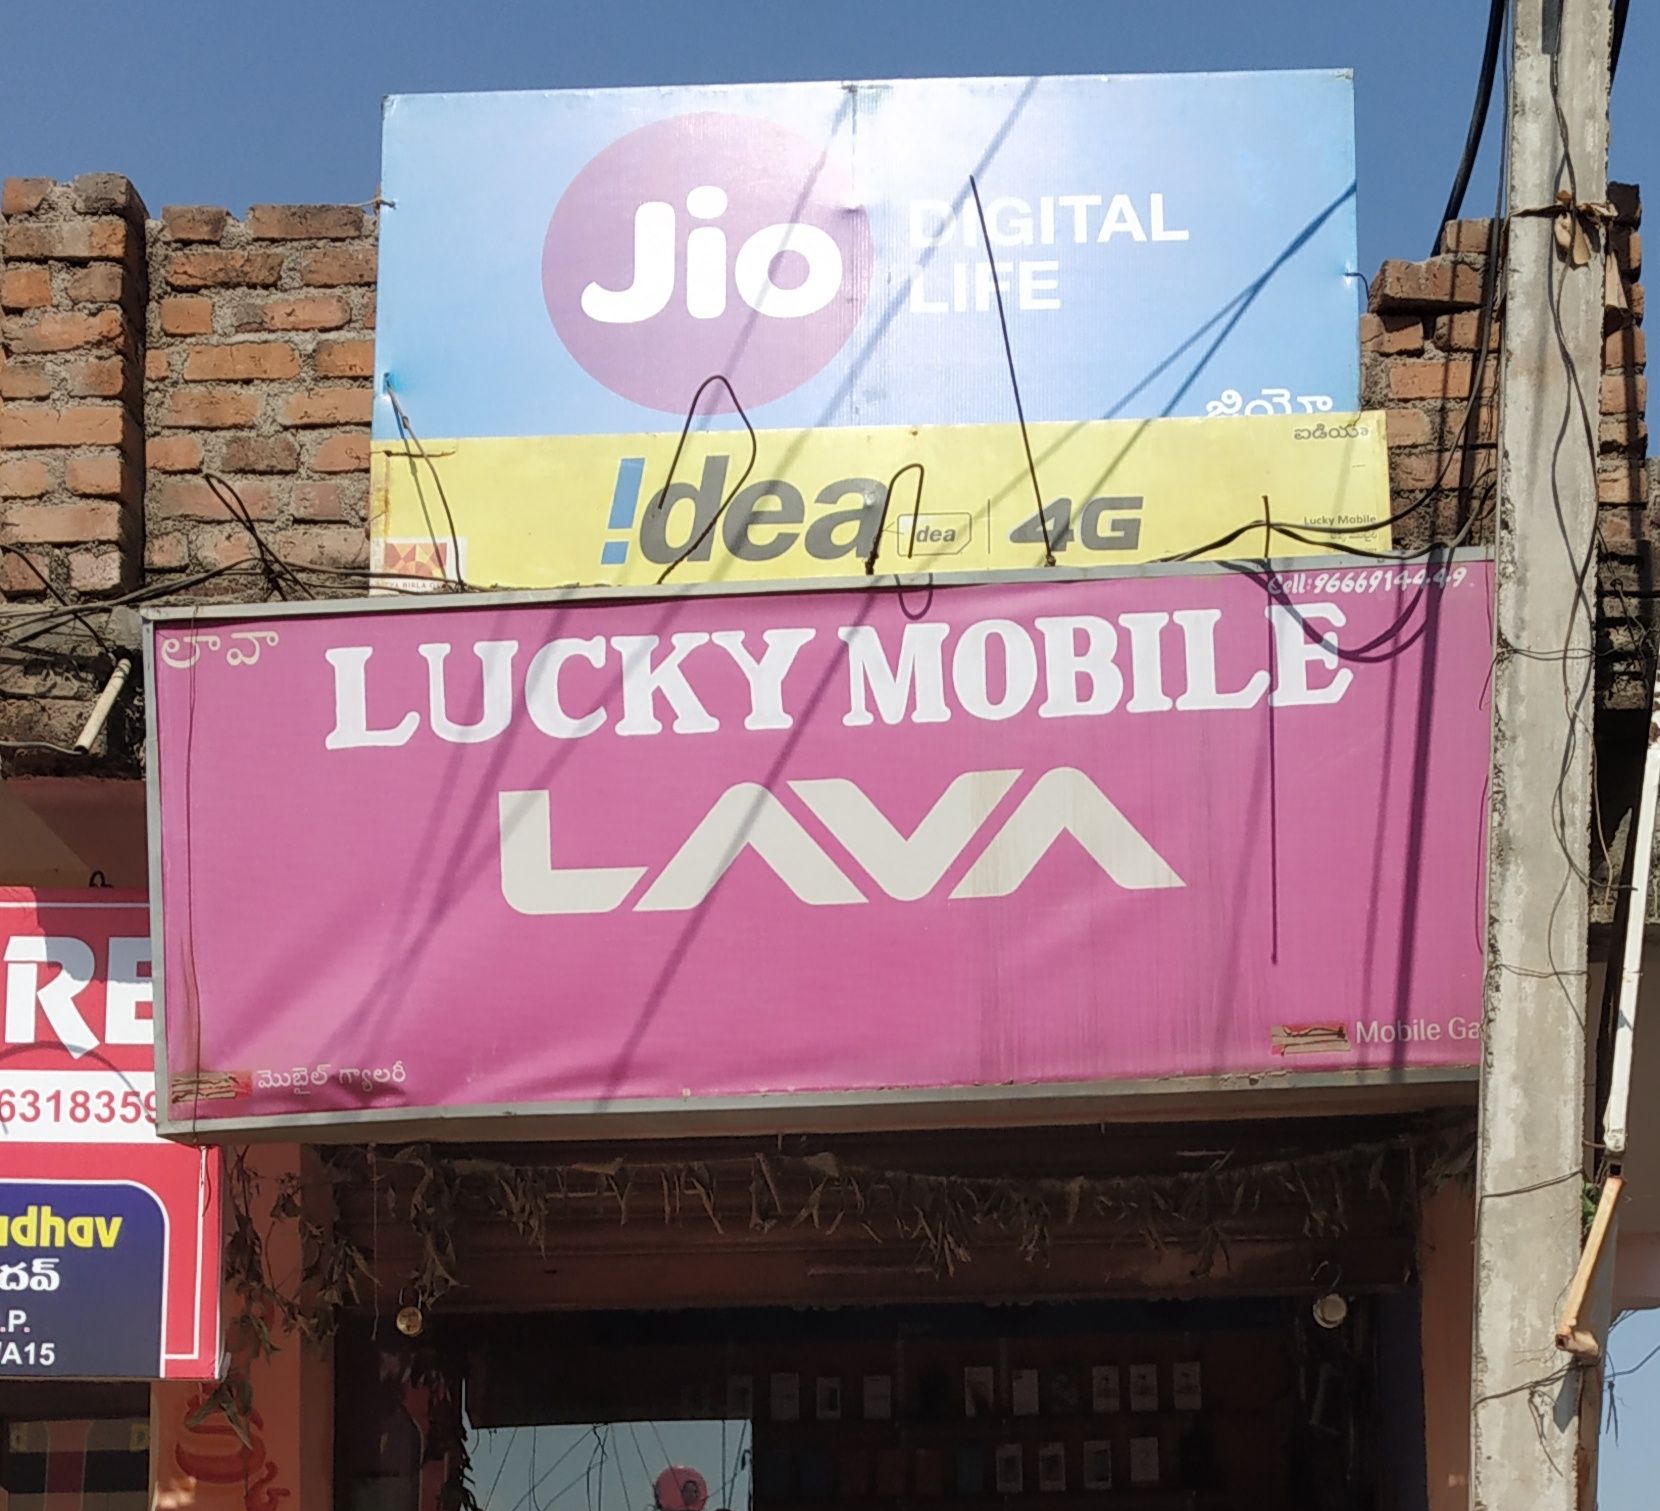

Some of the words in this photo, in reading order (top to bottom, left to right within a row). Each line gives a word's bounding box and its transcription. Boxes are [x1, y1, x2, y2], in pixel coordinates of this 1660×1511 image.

[908, 193, 1189, 249] DIGITAL
[581, 186, 843, 323] Jio
[908, 260, 1060, 313] LIFE
[1294, 423, 1369, 440] ఐడియా
[1010, 497, 1143, 551] 4G
[1304, 516, 1335, 526] Lucky
[1337, 515, 1376, 524] Mobile
[161, 631, 279, 668] లావా
[325, 628, 816, 750] LUCKY
[841, 602, 1354, 726] MOBILE
[499, 767, 1187, 914] LAVA
[1355, 1018, 1441, 1044] Mobile
[0, 1342, 55, 1365] A15
